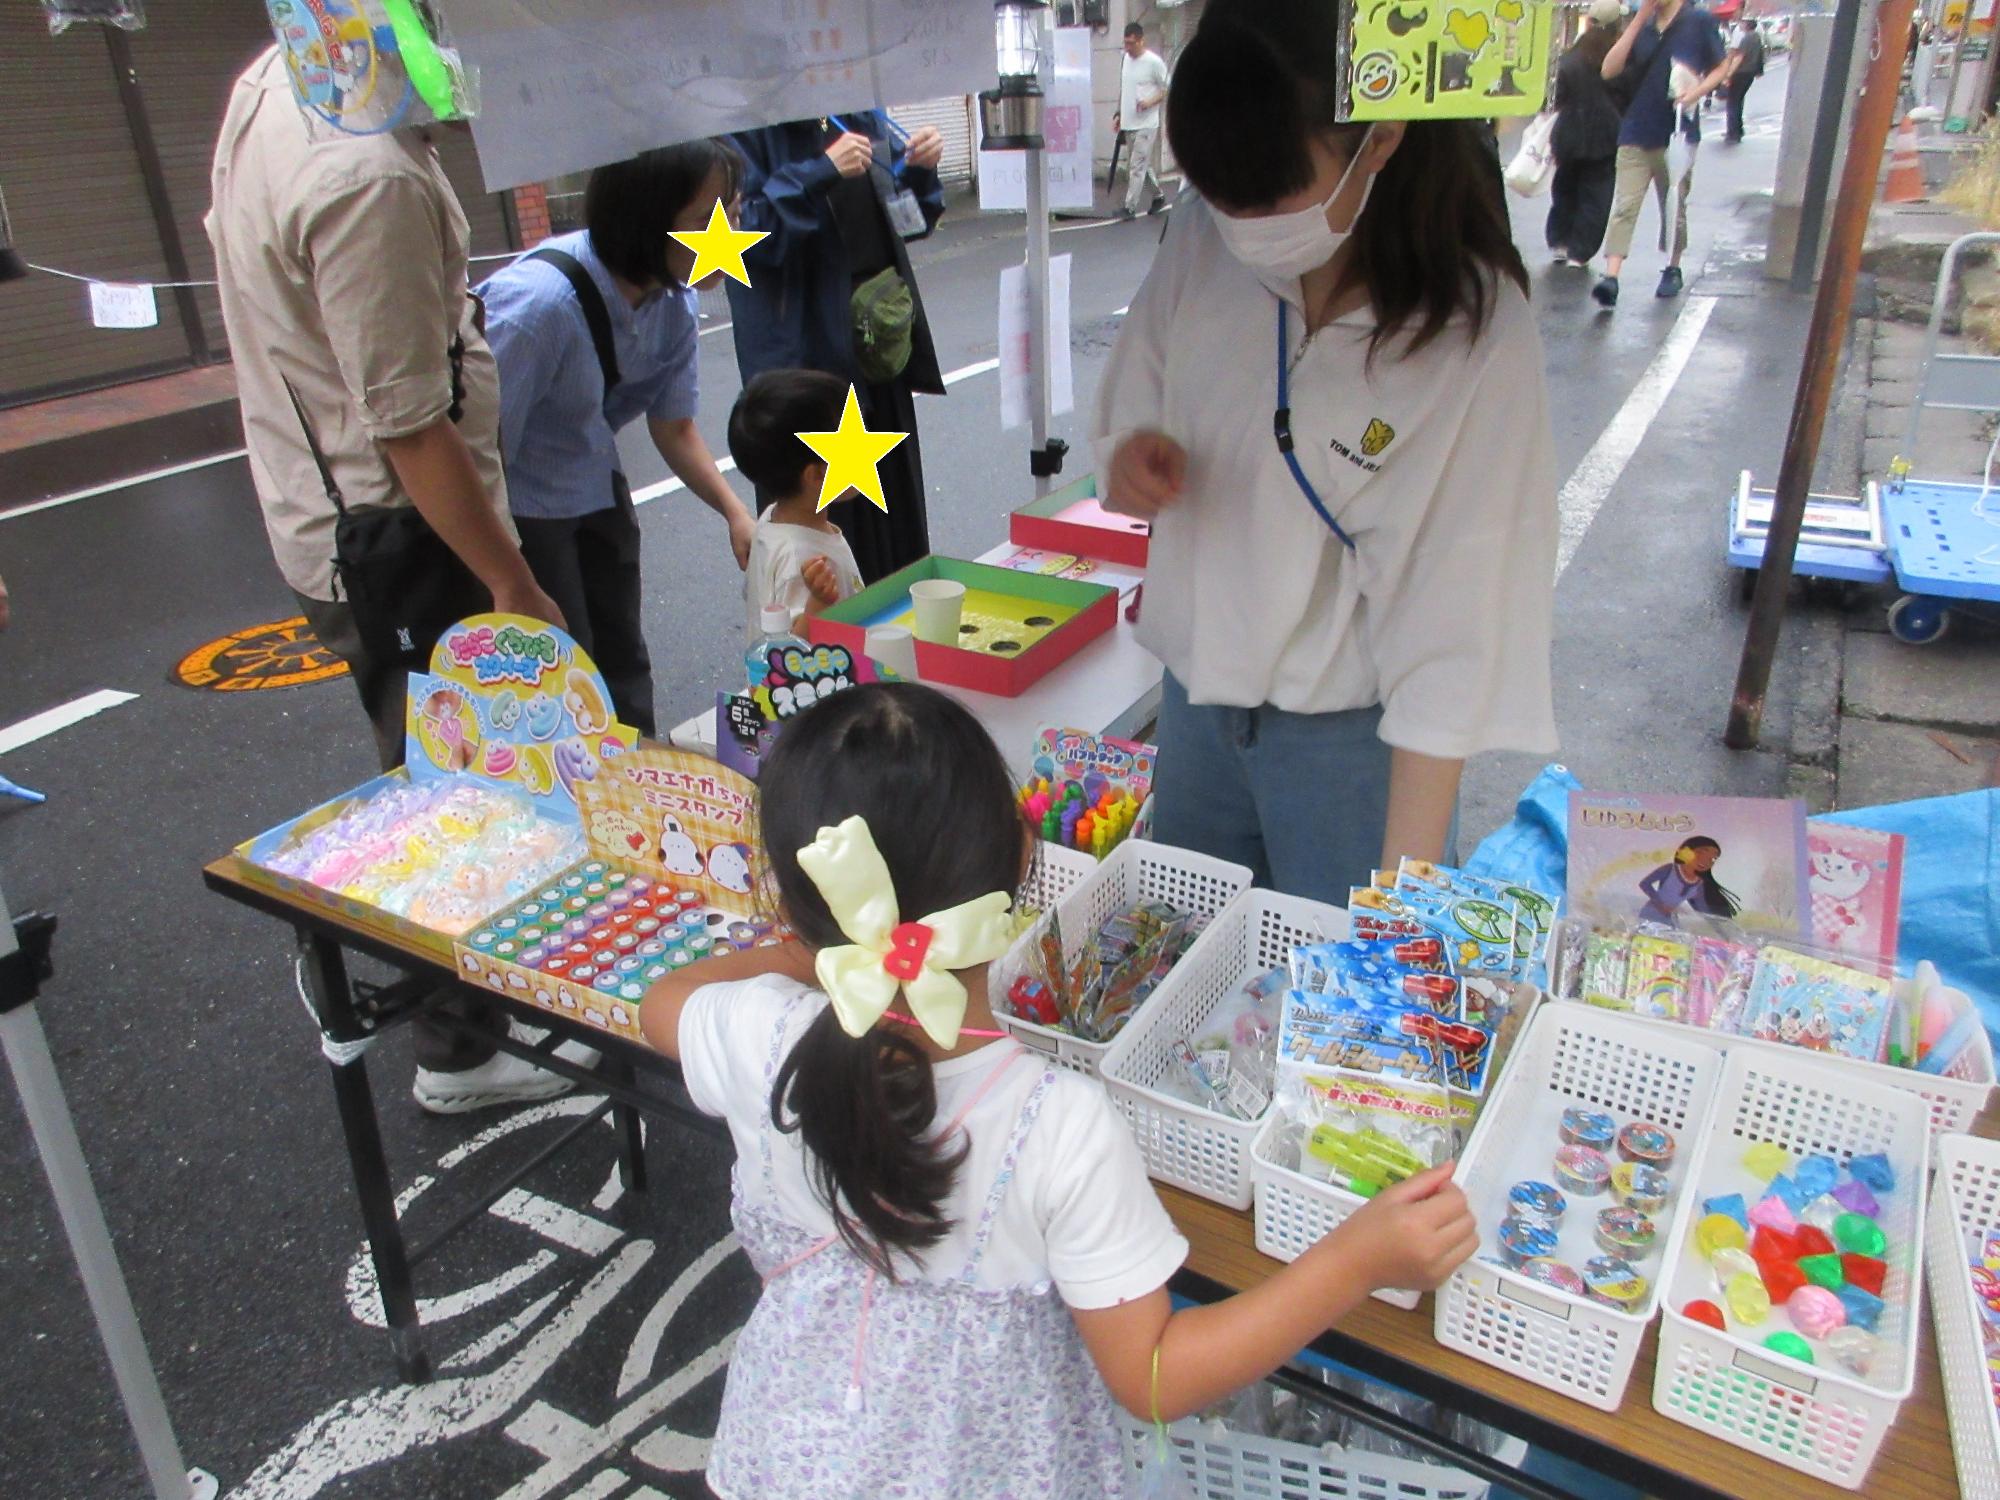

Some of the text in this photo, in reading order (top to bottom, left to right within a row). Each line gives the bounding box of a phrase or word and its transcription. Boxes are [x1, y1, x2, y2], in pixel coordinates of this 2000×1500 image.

[1329, 438, 1350, 457] TOM
[625, 766, 754, 811] シマエナガちゃん
[643, 788, 745, 826] ミニスタンプ
